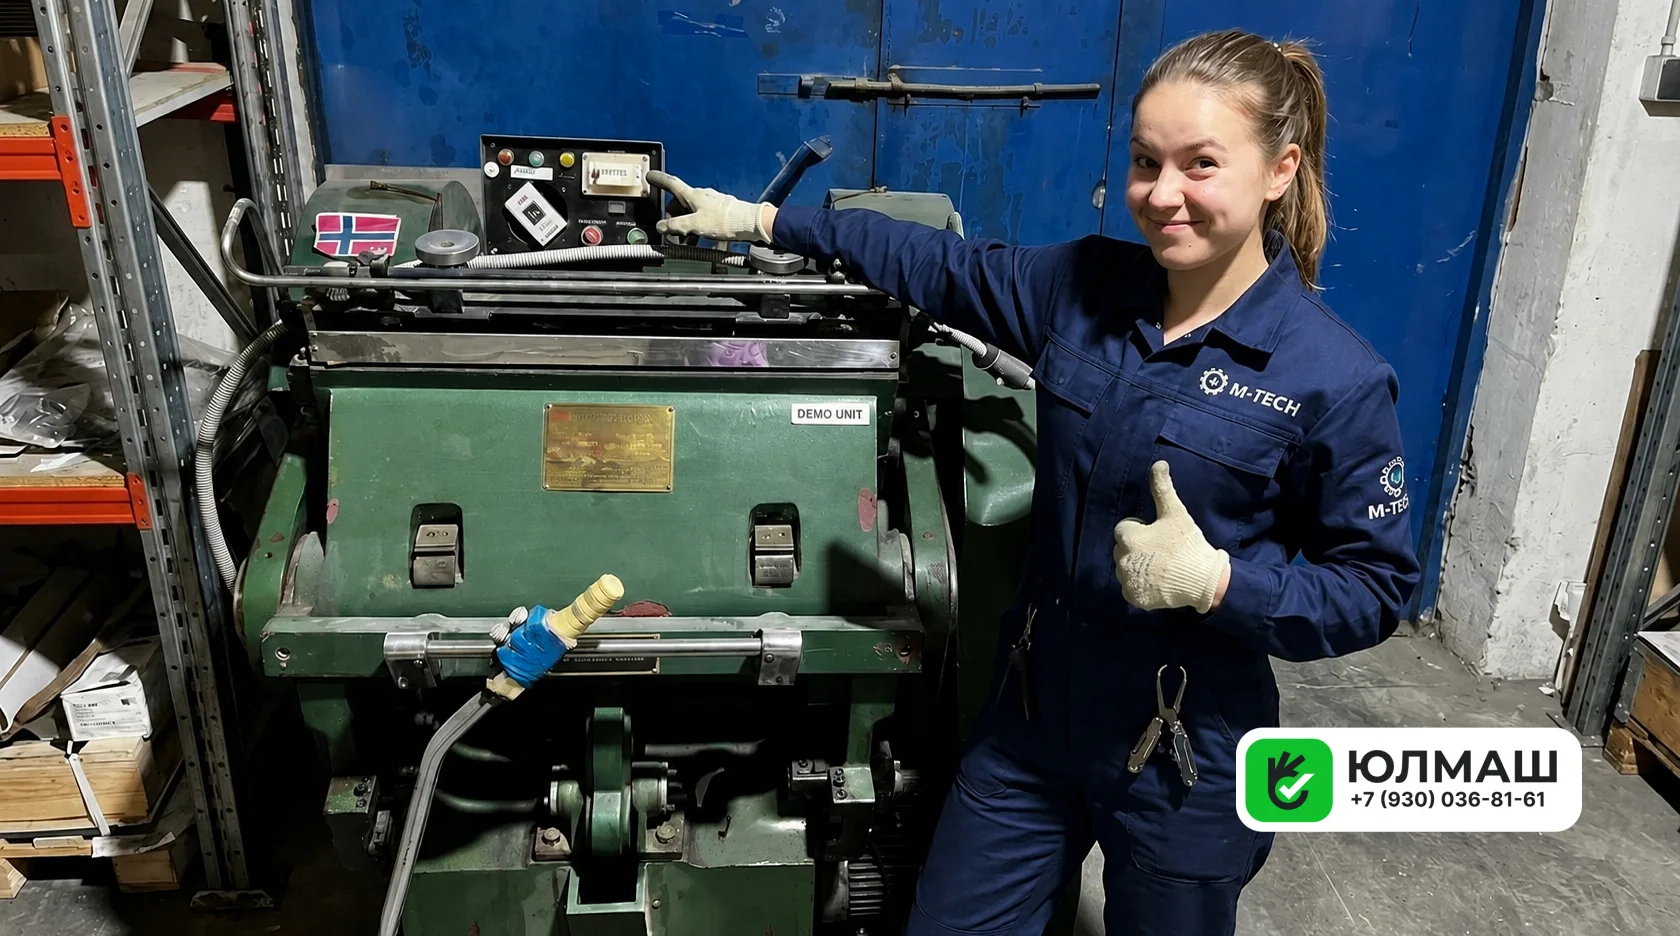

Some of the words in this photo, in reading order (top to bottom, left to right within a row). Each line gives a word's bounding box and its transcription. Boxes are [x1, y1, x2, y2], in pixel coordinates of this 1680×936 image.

[1229, 382, 1302, 417] M-TECH
[797, 408, 832, 419] DEMO
[835, 409, 863, 419] UNIT
[1368, 493, 1409, 520] M-TEC
